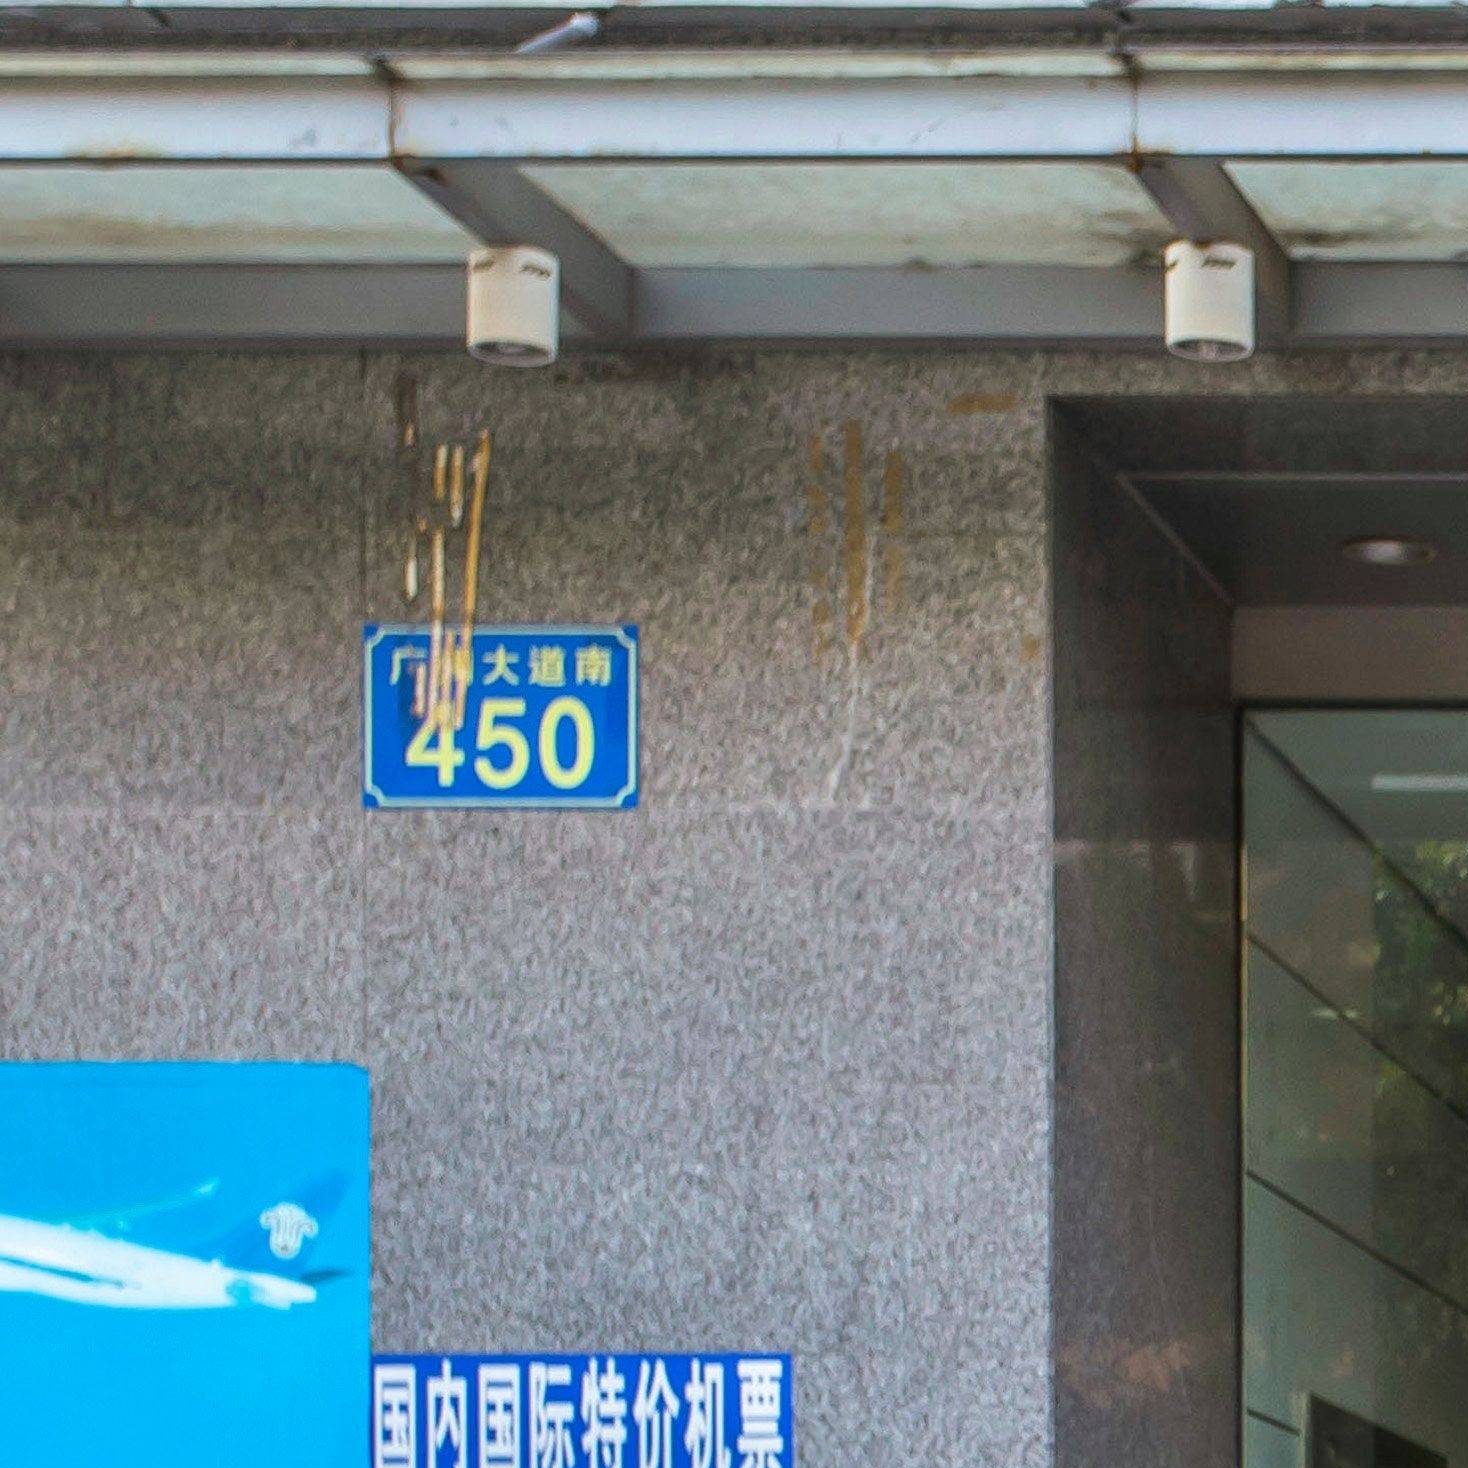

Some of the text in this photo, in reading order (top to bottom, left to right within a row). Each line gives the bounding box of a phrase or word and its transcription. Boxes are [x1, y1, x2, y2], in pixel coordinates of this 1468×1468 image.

[389, 643, 612, 687] 广大道南
[404, 695, 595, 790] 450
